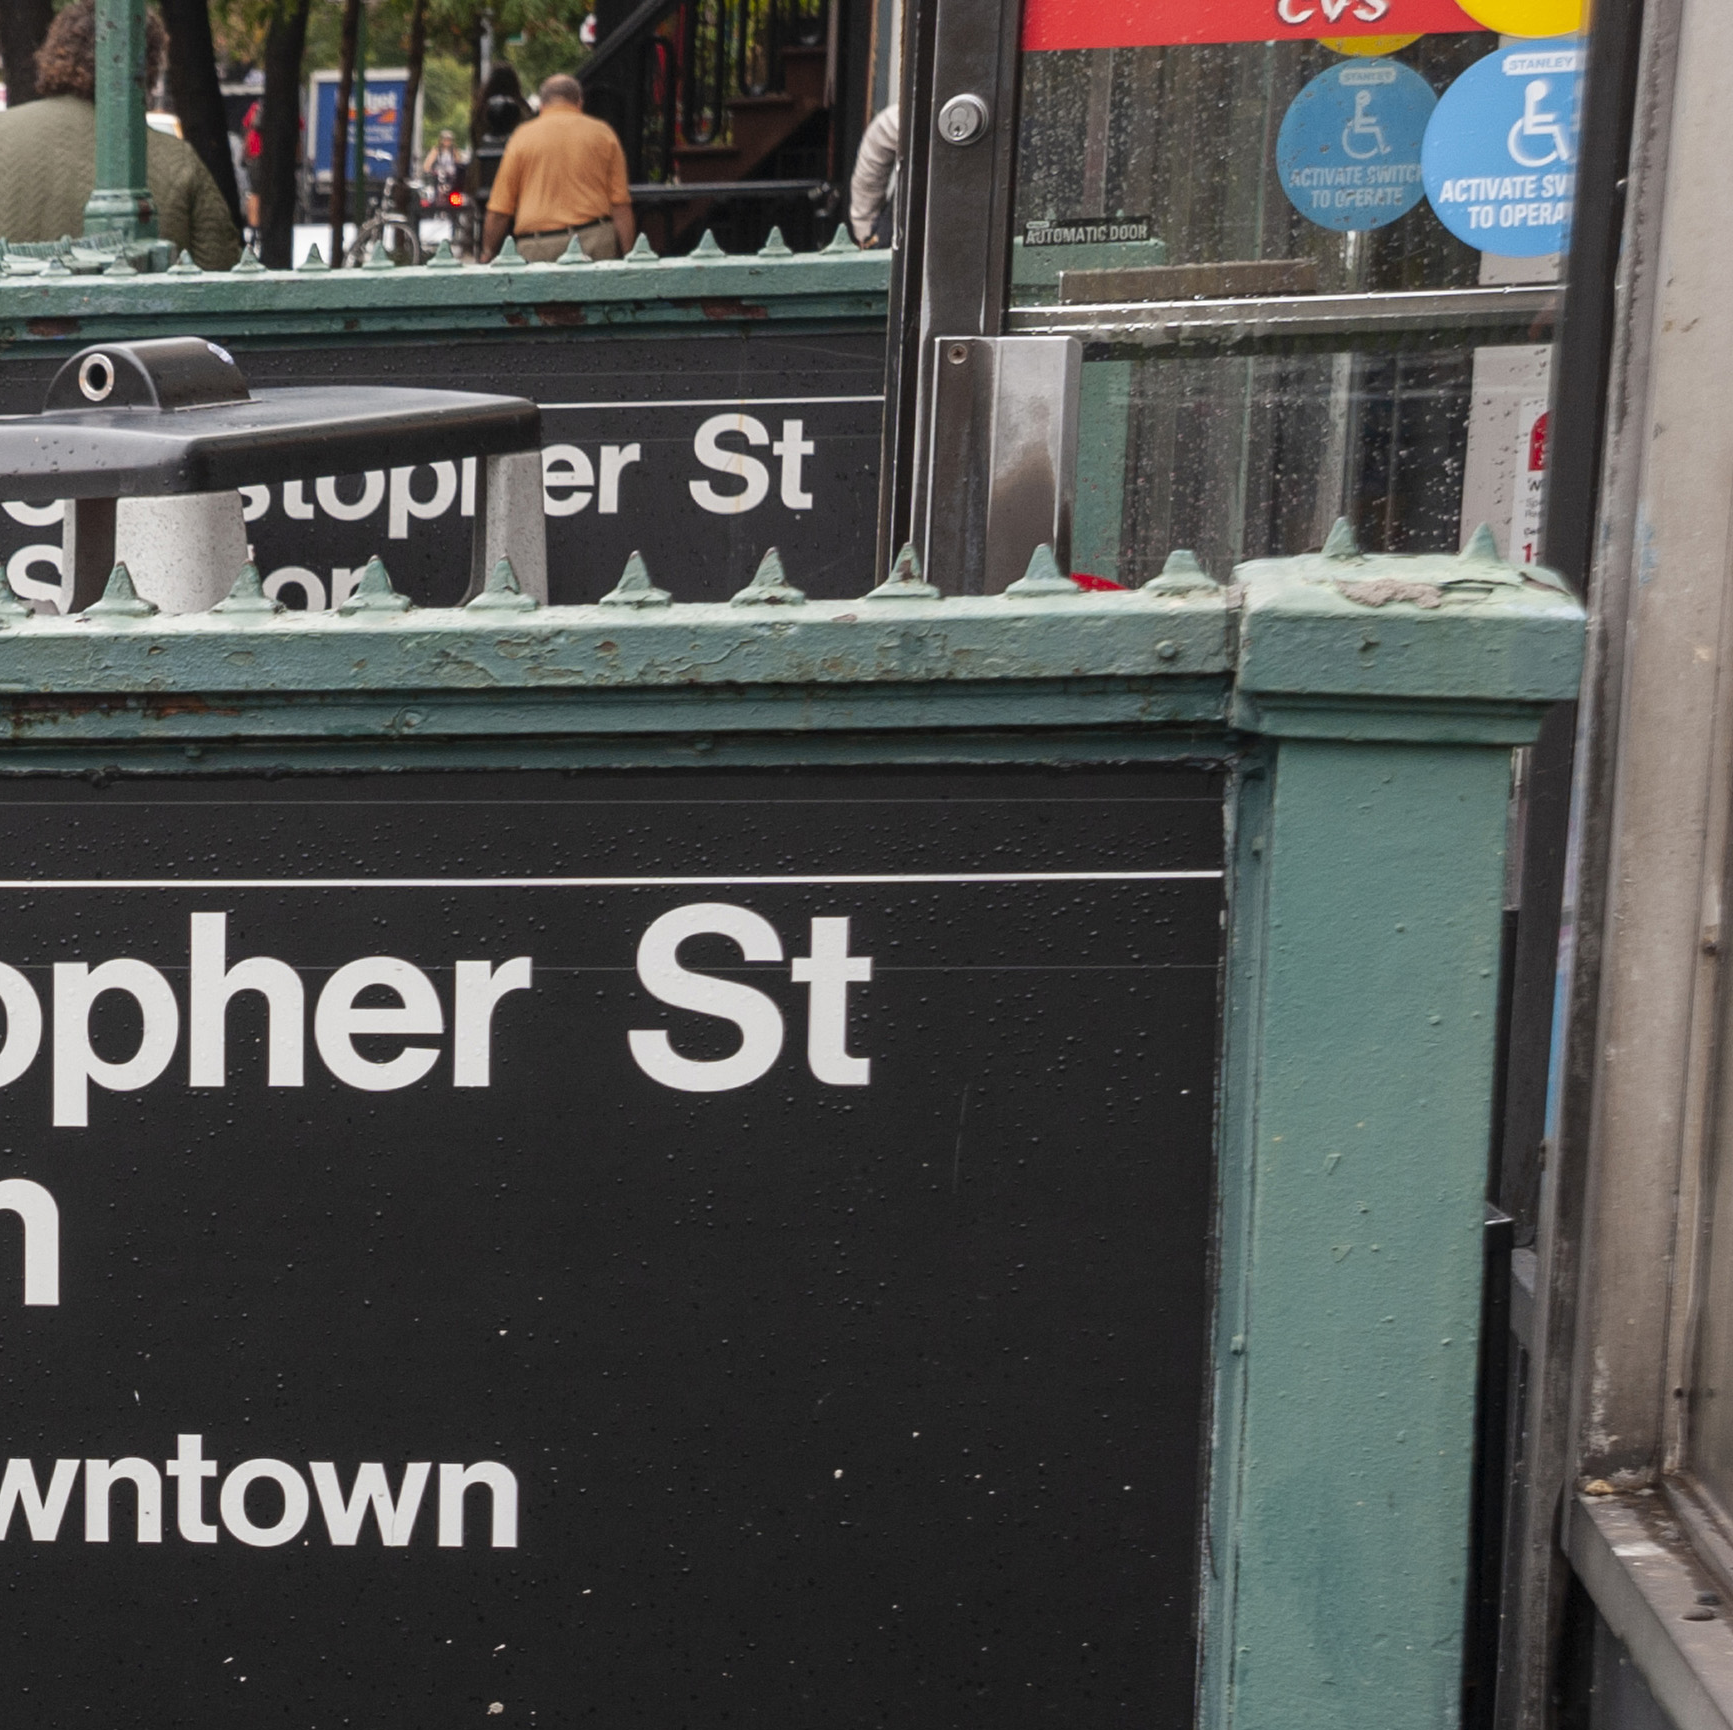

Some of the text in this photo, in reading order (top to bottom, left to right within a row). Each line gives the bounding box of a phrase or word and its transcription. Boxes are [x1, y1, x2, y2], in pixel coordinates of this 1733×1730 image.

[1289, 166, 1364, 188] ACTIVATE
[1438, 175, 1538, 203] ACTIVATE
[1310, 187, 1404, 208] TO OPERATE
[1467, 202, 1569, 229] TO OPERA
[1025, 225, 1108, 245] AUTOMATIC
[1110, 224, 1148, 241] DOOR
[688, 413, 815, 515] St
[629, 903, 871, 1091] St
